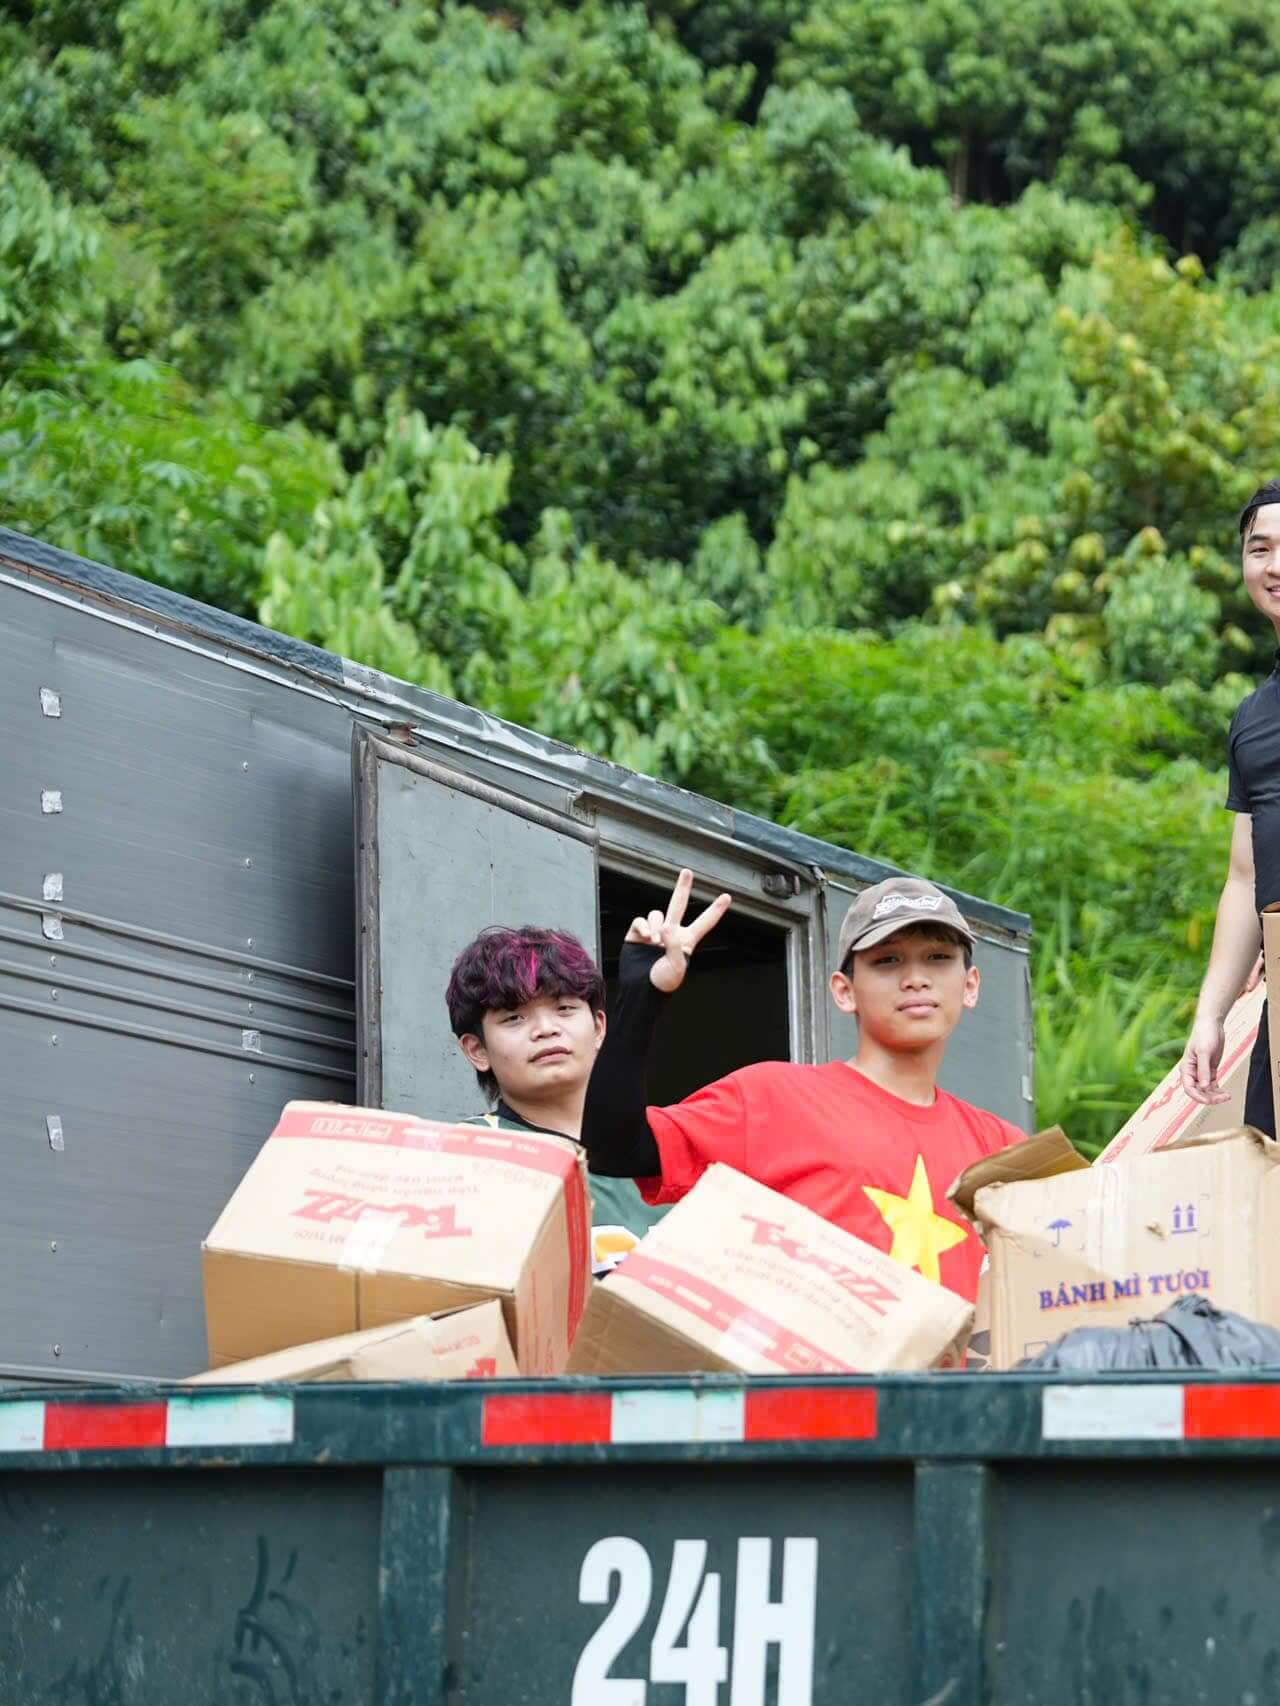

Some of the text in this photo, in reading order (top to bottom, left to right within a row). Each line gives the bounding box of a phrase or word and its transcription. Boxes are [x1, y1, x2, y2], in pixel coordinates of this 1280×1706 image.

[1039, 1267, 1211, 1310] BÁNH MÌ TƯƠI
[570, 1535, 818, 1706] 24H
